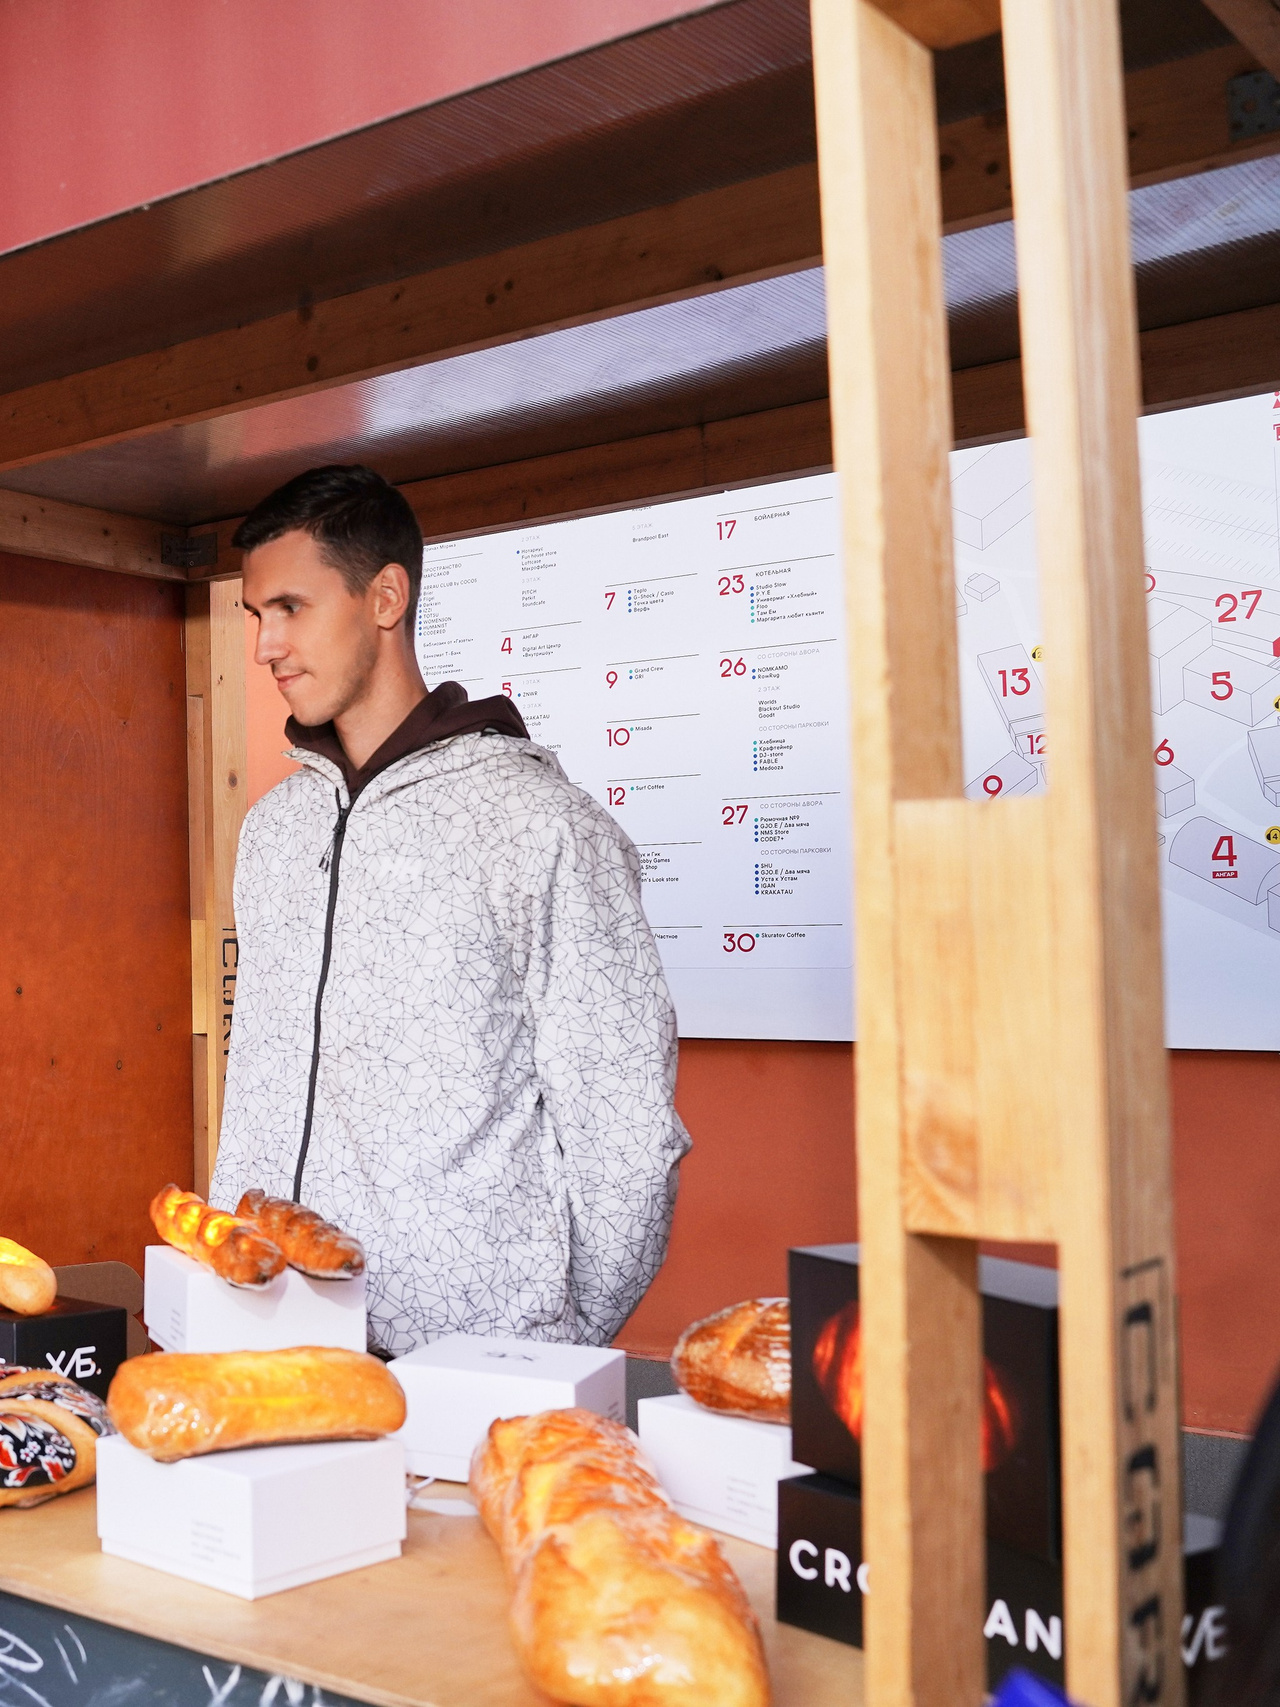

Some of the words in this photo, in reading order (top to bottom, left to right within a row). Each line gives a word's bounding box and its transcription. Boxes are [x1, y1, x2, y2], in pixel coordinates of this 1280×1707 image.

[754, 511, 790, 522] БОЙЛЕРНАЯ
[716, 520, 736, 540] 17
[756, 568, 792, 577] КОТЕЛЬНАЯ
[718, 574, 744, 596] 23
[604, 592, 616, 610] 7
[1214, 589, 1262, 623] 27
[756, 615, 786, 623] Маргарита
[501, 637, 512, 654] 4
[768, 650, 798, 659] СТОРОНЫ
[720, 657, 746, 678] 26
[606, 670, 618, 688] 9
[998, 667, 1032, 698] 13
[1210, 671, 1234, 701] 5
[502, 682, 512, 698] 5
[606, 728, 630, 747] 10
[1153, 738, 1174, 766] 6
[606, 787, 626, 806] 12
[982, 774, 1003, 801] 9
[722, 804, 749, 826] 27
[1211, 836, 1238, 866] 4
[722, 932, 756, 953] 30
